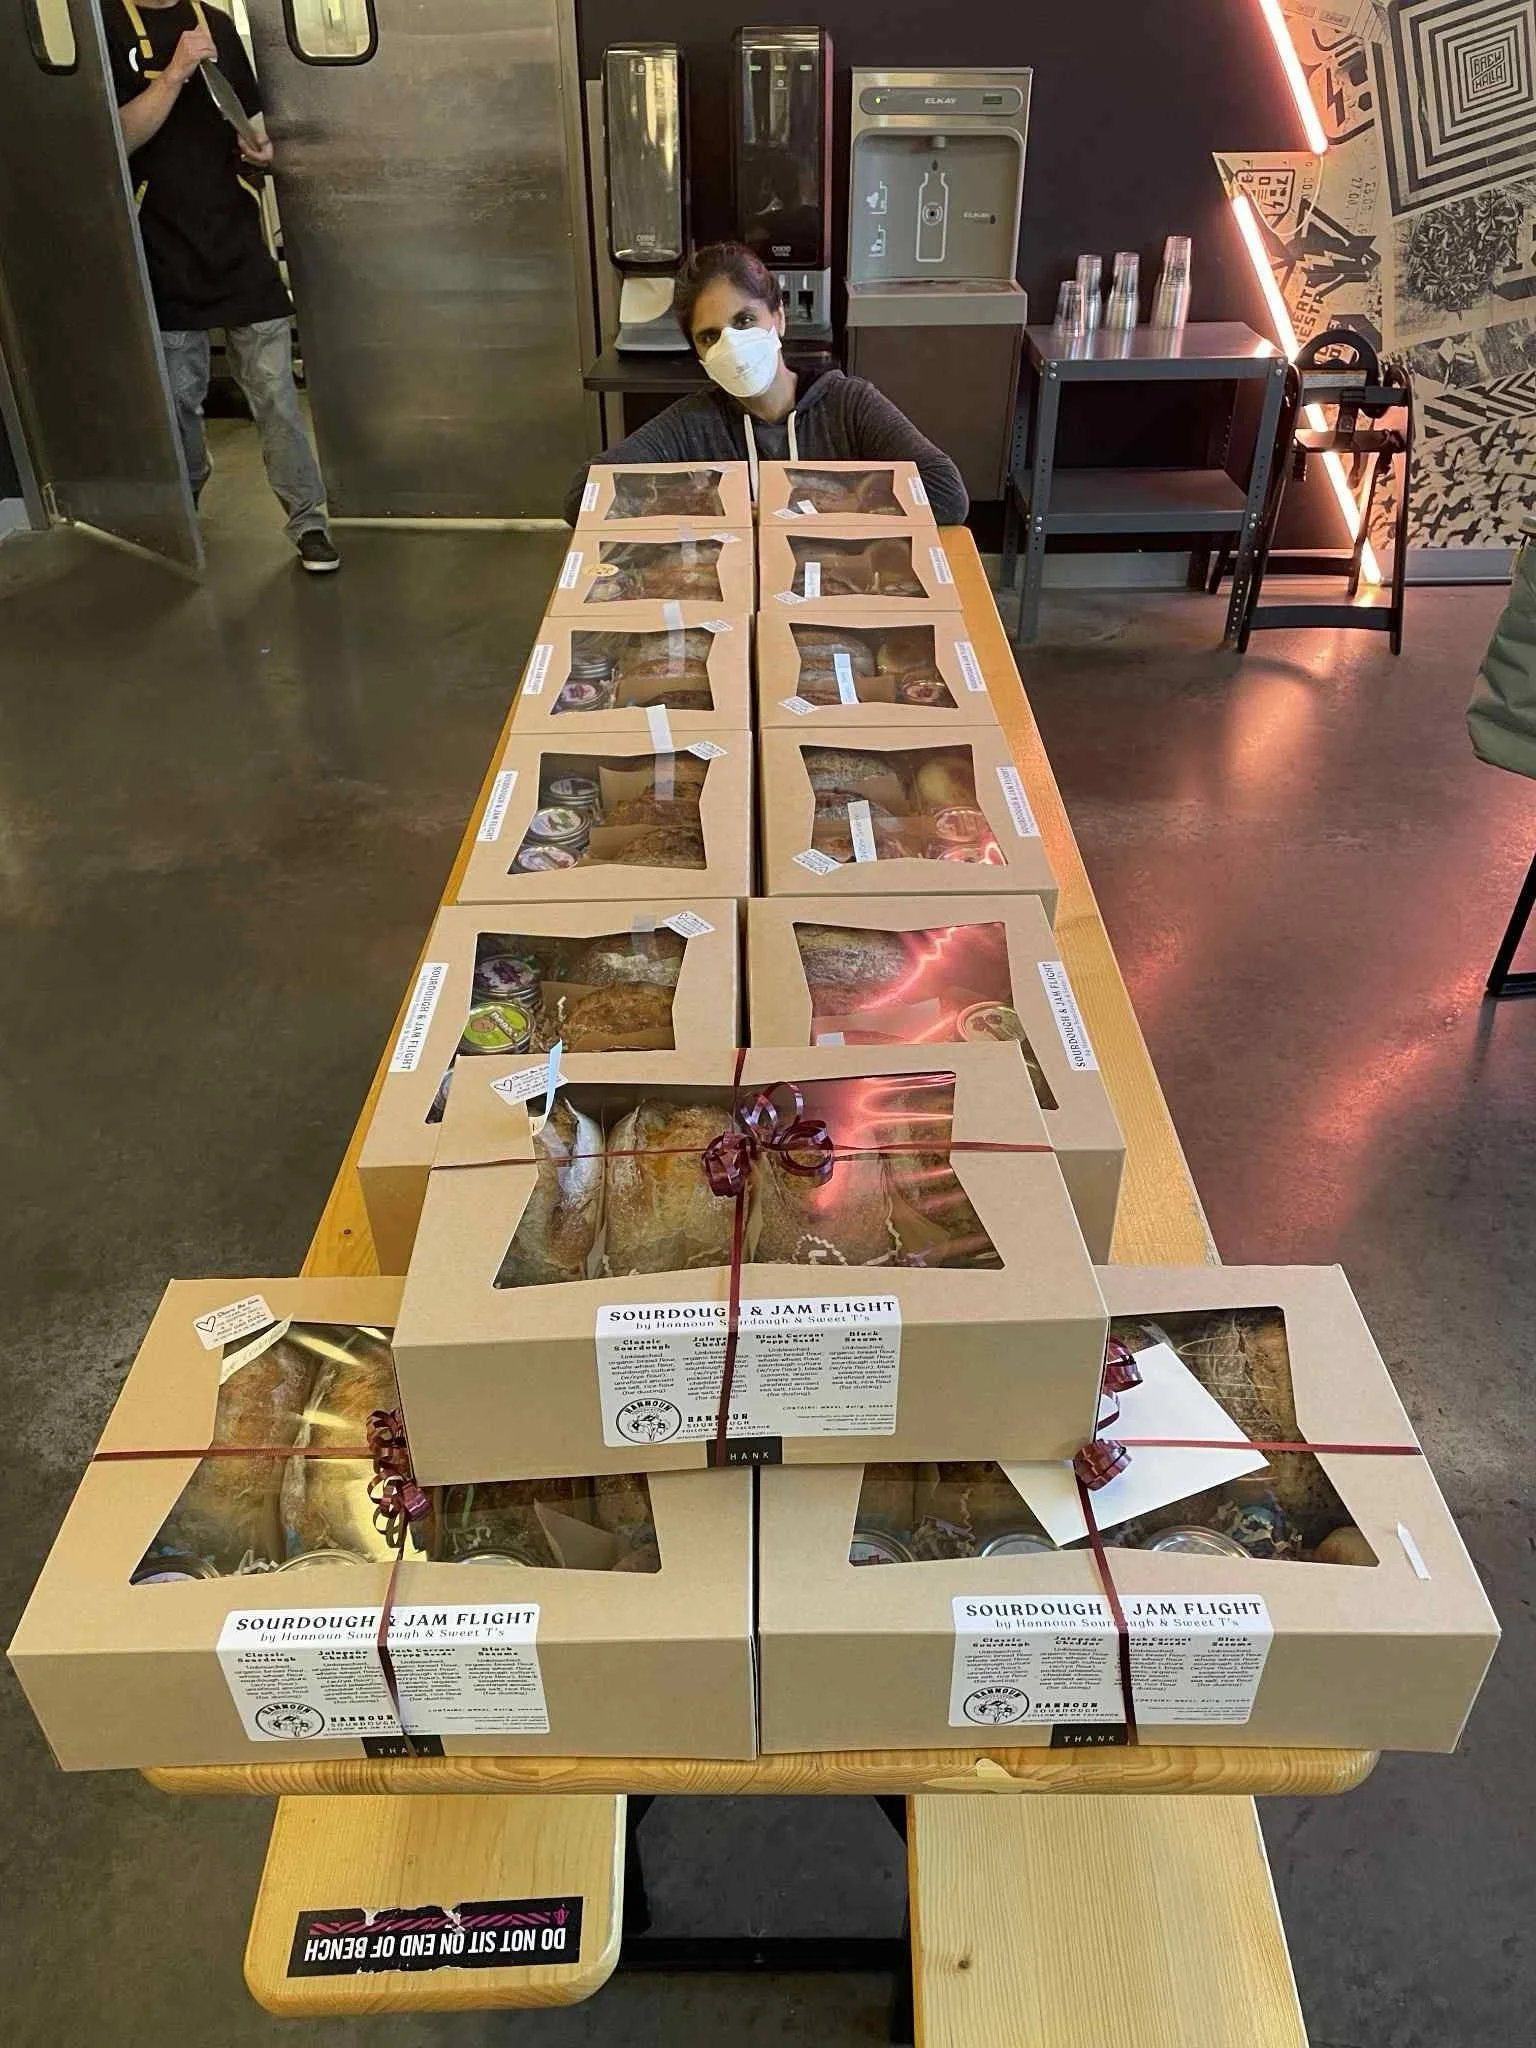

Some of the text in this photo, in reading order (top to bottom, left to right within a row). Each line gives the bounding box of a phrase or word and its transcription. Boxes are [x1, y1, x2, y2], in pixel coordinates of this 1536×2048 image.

[924, 97, 957, 105] ELKAY
[1042, 963, 1060, 990] FLIGHT
[418, 966, 441, 1012] SOURDOUGH
[1051, 991, 1066, 1006] JAM
[412, 1021, 425, 1039] JAM
[1060, 1015, 1087, 1067] SOURDOUGH
[402, 1040, 418, 1070] FLIGHT
[750, 1306, 762, 1316] &
[771, 1304, 813, 1315] JAM
[820, 1301, 895, 1314] FLIGHT
[635, 1322, 651, 1330] by
[656, 1321, 714, 1329] Hannoun
[808, 1315, 846, 1323] Sweet
[625, 1400, 672, 1414] HANNOUN
[730, 1451, 769, 1462] HANK
[966, 1602, 1261, 1617] SOURDOUGH JAM FLIGHT
[236, 1616, 376, 1631] SOURDOUGH
[404, 1614, 447, 1627] JAM
[456, 1612, 535, 1625] FLIGHT
[995, 1620, 1011, 1630] by
[1016, 1619, 1076, 1629] Hannoun
[1159, 1618, 1168, 1627] &
[1173, 1618, 1214, 1628] Sweet
[1218, 1617, 1239, 1627] T's
[260, 1627, 505, 1642] by Hannoun Sourough & Sweet T's
[1063, 1735, 1115, 1743] THANK
[377, 1745, 430, 1755] THAK
[304, 1928, 566, 1962] DO NOT SIT ON END OF BENCH
